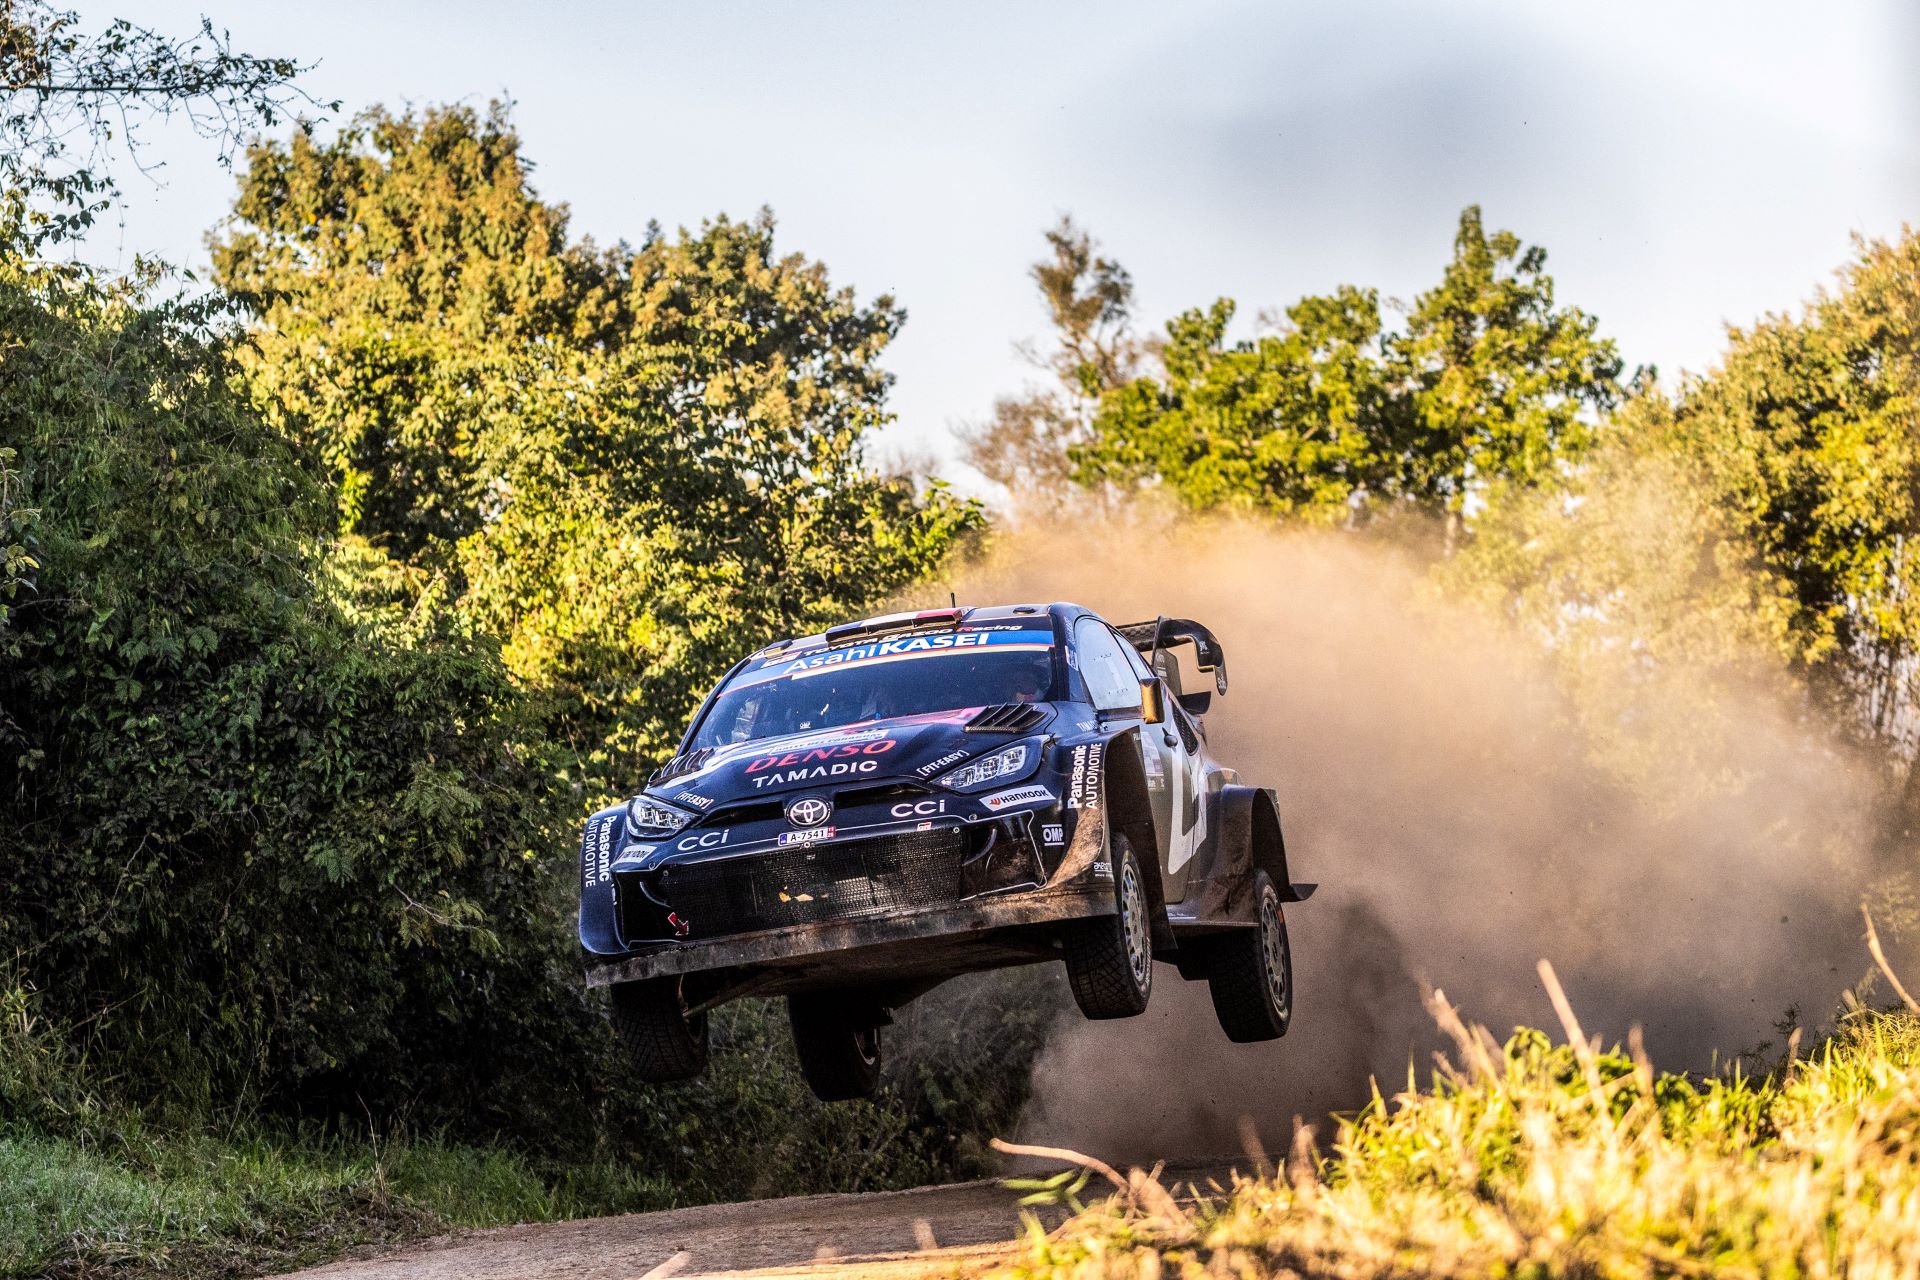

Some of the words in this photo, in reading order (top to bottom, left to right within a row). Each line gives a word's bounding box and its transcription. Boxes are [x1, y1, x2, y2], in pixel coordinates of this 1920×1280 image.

[745, 740, 896, 773] DENSO
[752, 760, 878, 788] TAMADIC
[1067, 745, 1087, 809] Panasonic
[1085, 743, 1102, 810] AUTOMOTIVE
[585, 819, 600, 888] AUTOMOTIVE
[598, 815, 617, 882] Panasonic
[790, 829, 824, 842] A-7541
[1043, 827, 1064, 842] OMP
